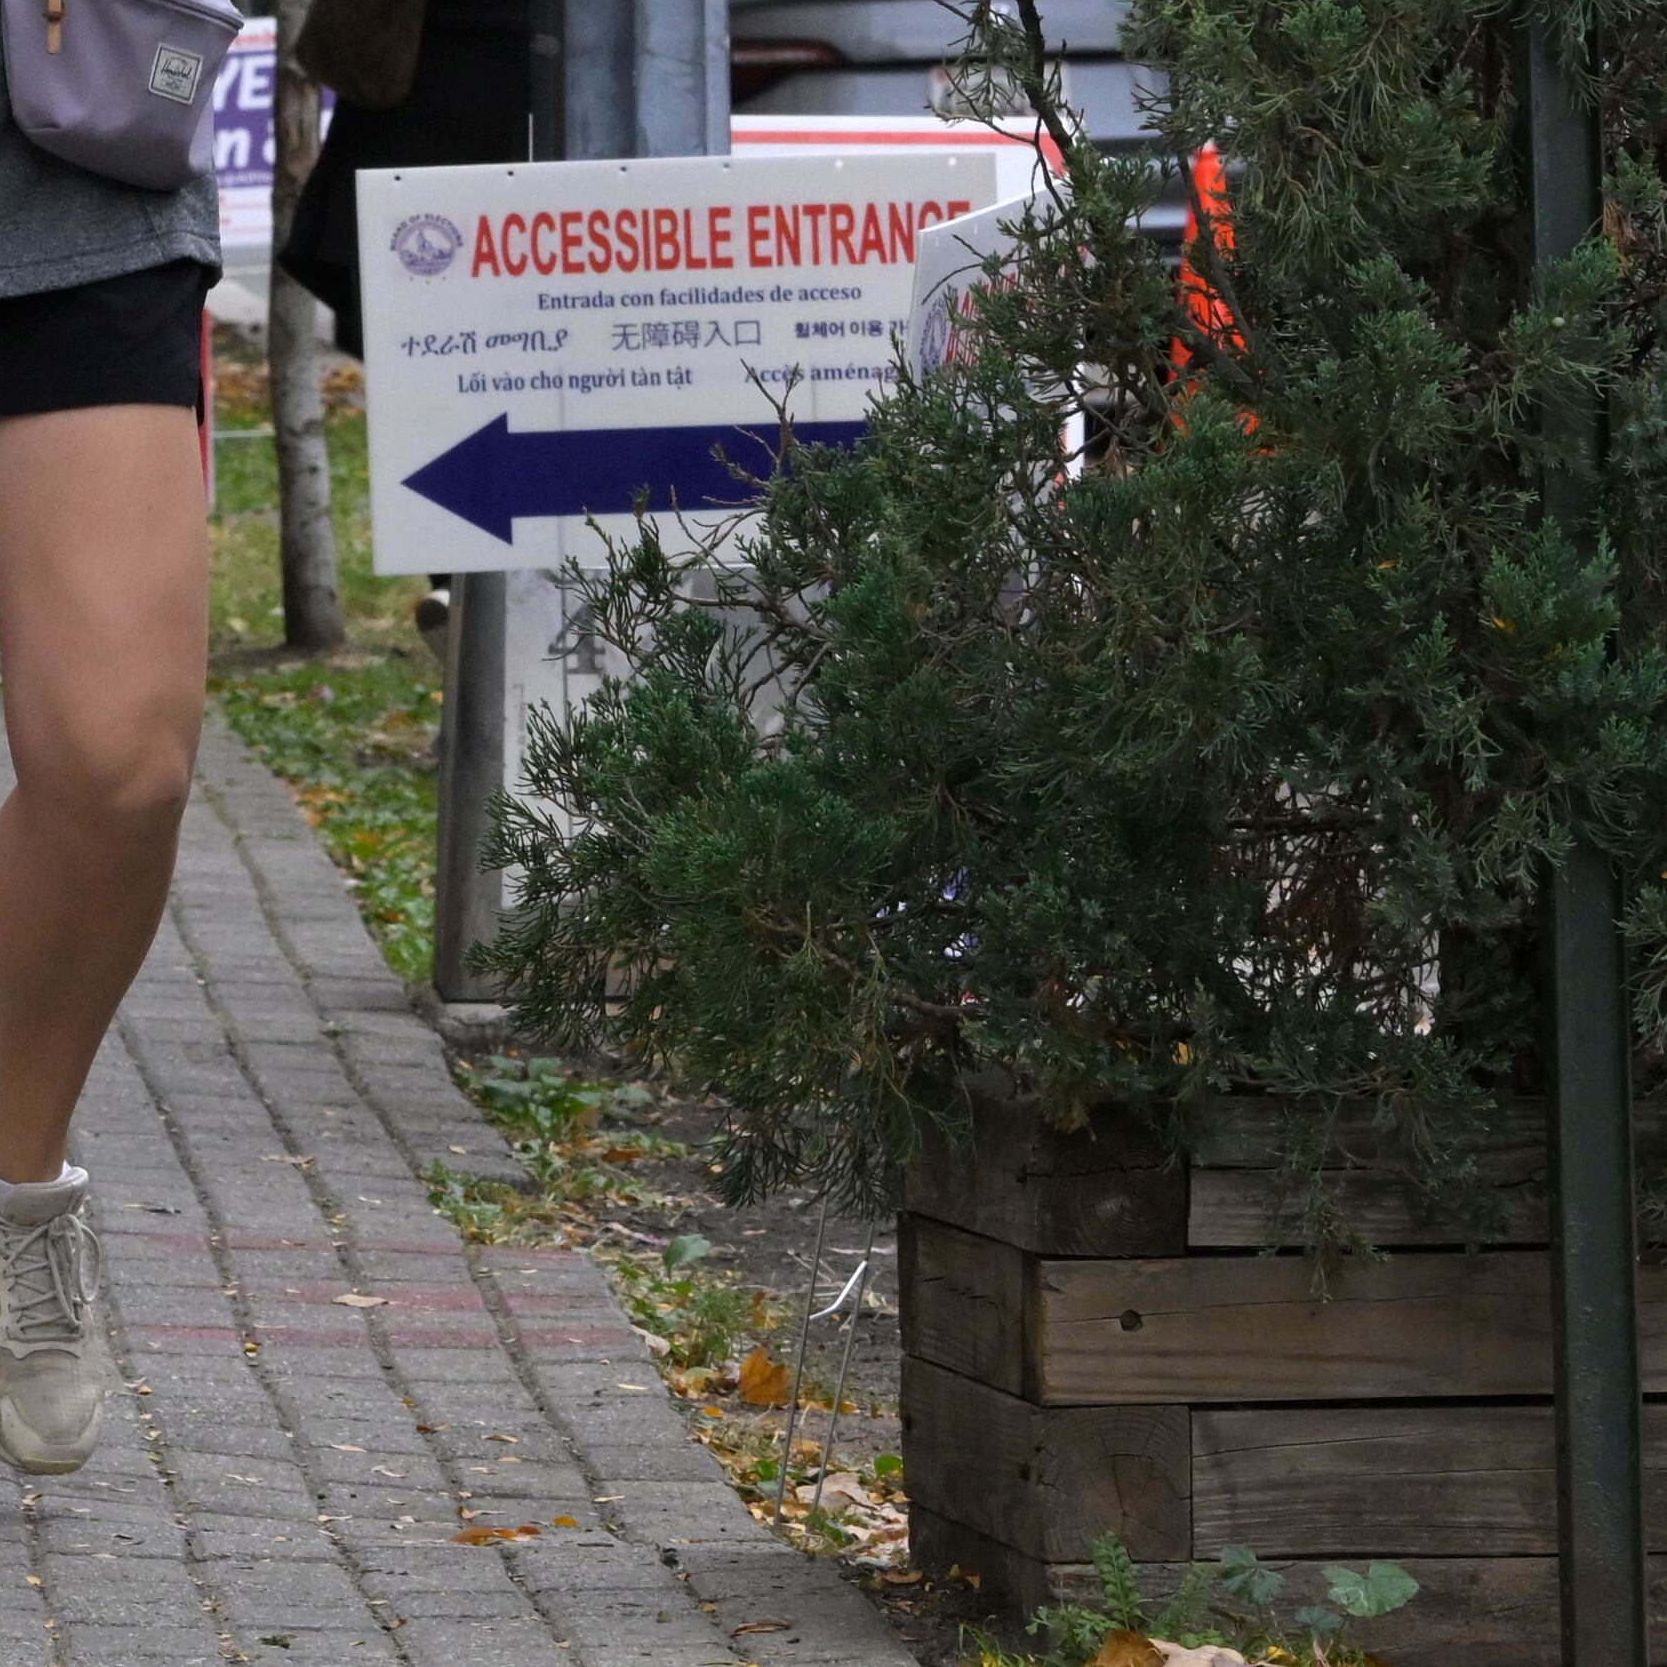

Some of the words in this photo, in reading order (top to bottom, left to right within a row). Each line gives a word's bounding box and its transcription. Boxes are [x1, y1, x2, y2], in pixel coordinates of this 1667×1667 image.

[470, 205, 734, 278] ACCESSIBLE
[747, 199, 971, 268] ENTRAN
[538, 290, 615, 311] Entrada
[620, 293, 655, 308] con
[660, 285, 765, 307] facilidades
[769, 285, 794, 304] de
[798, 287, 863, 302] acceso
[611, 319, 762, 352] 无障碍入口
[849, 320, 883, 337] 이용
[458, 370, 488, 394] Lối
[491, 371, 525, 392] vào
[530, 370, 564, 390] cho
[568, 367, 626, 394] người
[632, 365, 661, 387] tàn
[667, 366, 693, 390] tật
[810, 361, 897, 384] aménag
